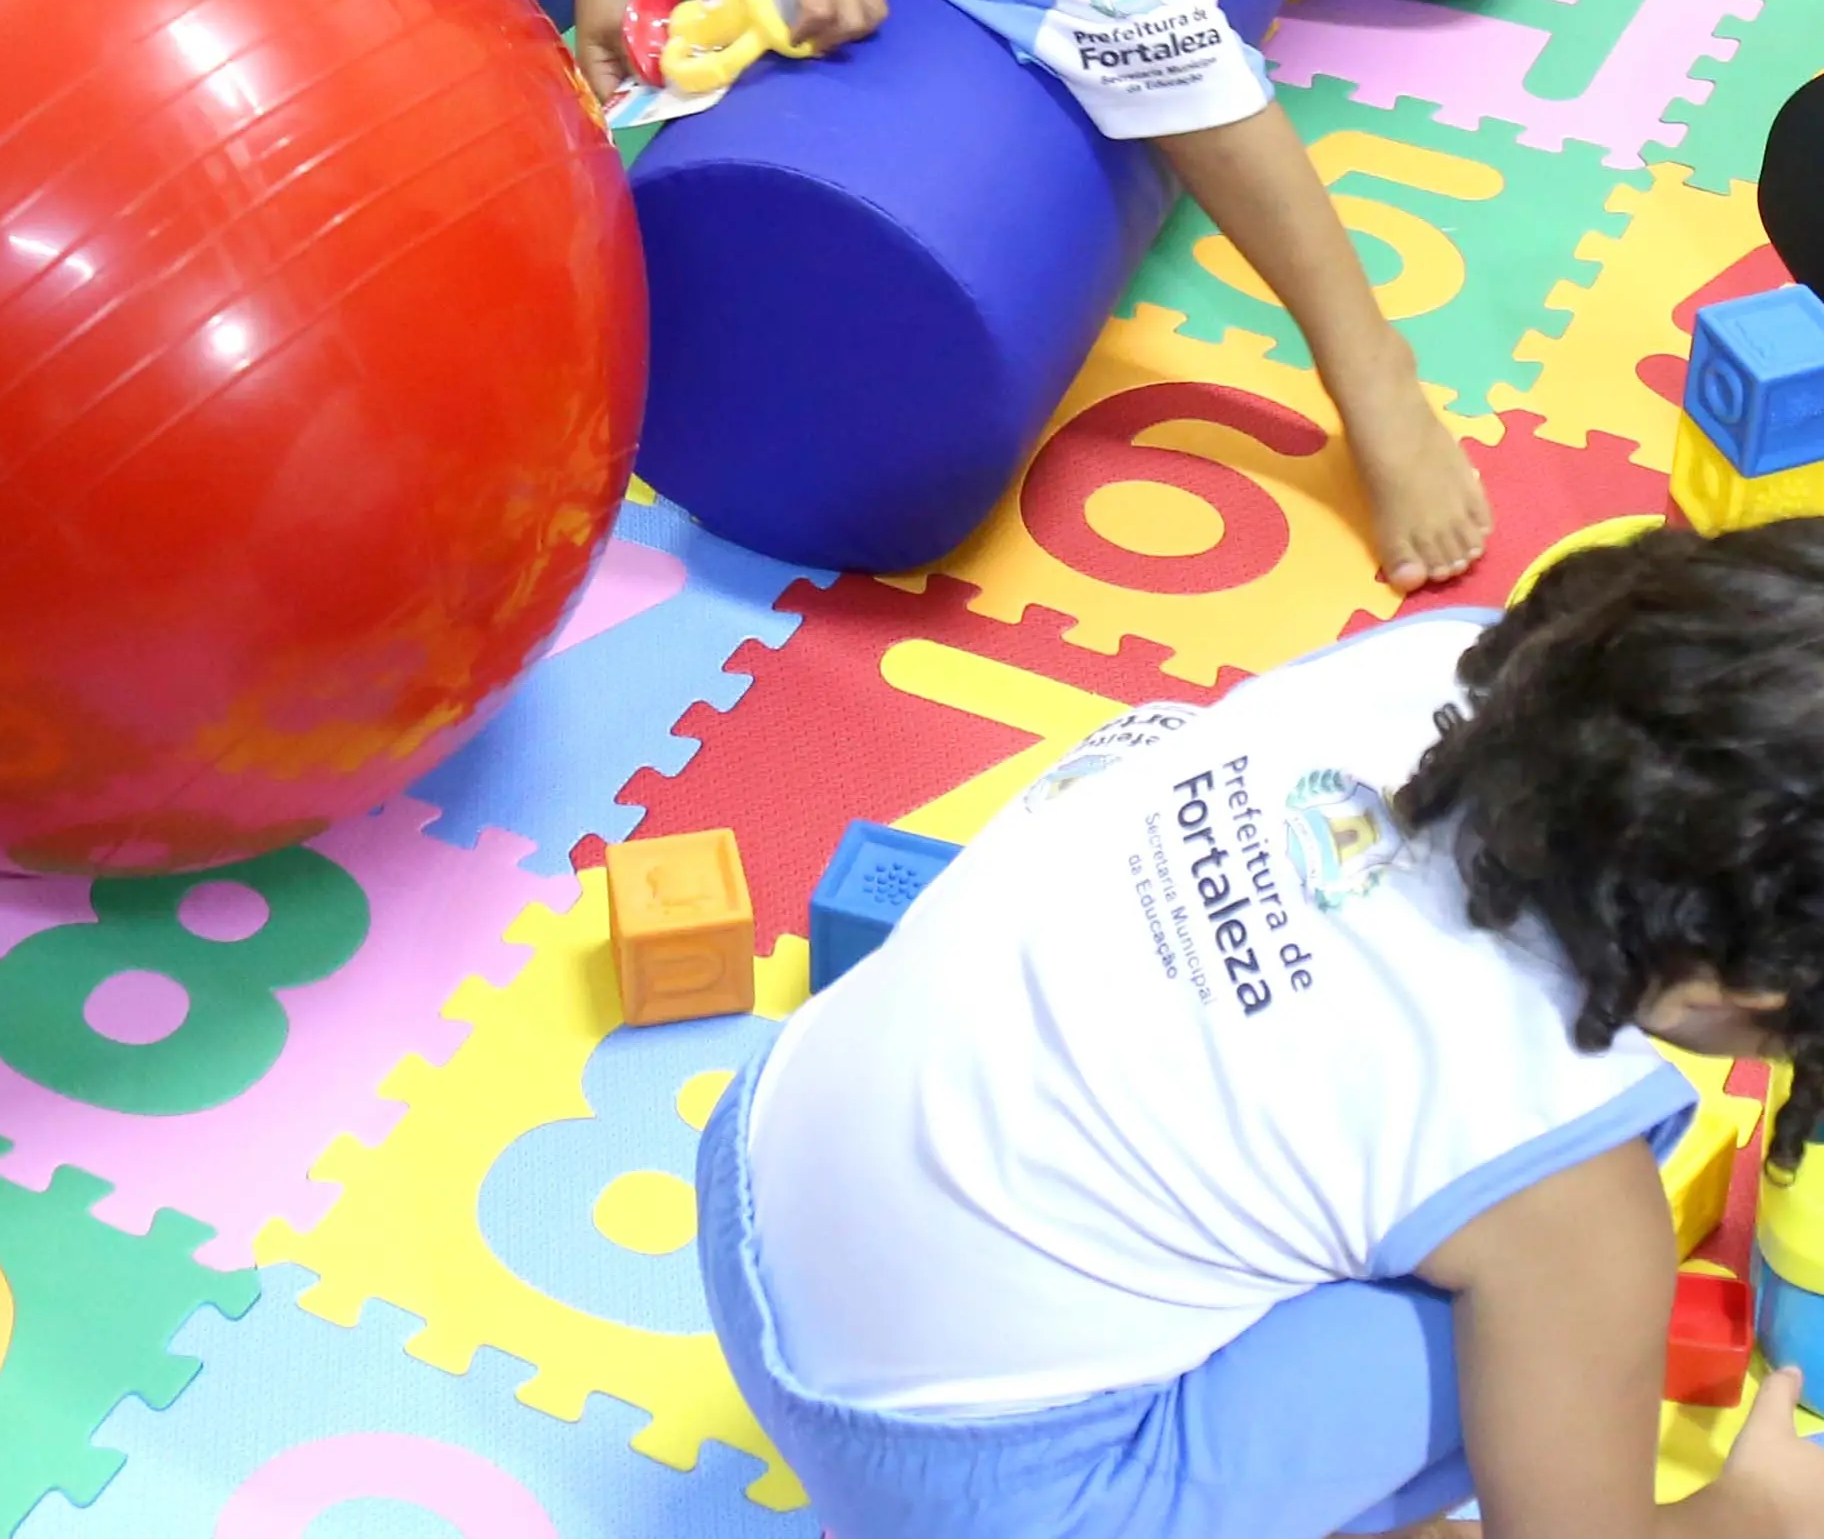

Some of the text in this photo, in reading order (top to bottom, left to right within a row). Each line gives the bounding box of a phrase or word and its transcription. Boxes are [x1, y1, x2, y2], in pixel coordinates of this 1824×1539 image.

[1074, 6, 1209, 43] Prefeitura de
[1079, 27, 1223, 71] Fortaleza
[1021, 381, 1329, 593] 6
[1127, 853, 1178, 981] da Educação
[1144, 811, 1216, 1007] Secretaria Municipal
[1172, 769, 1274, 1019] Fortaleza
[1222, 754, 1314, 993] Prefeitura de
